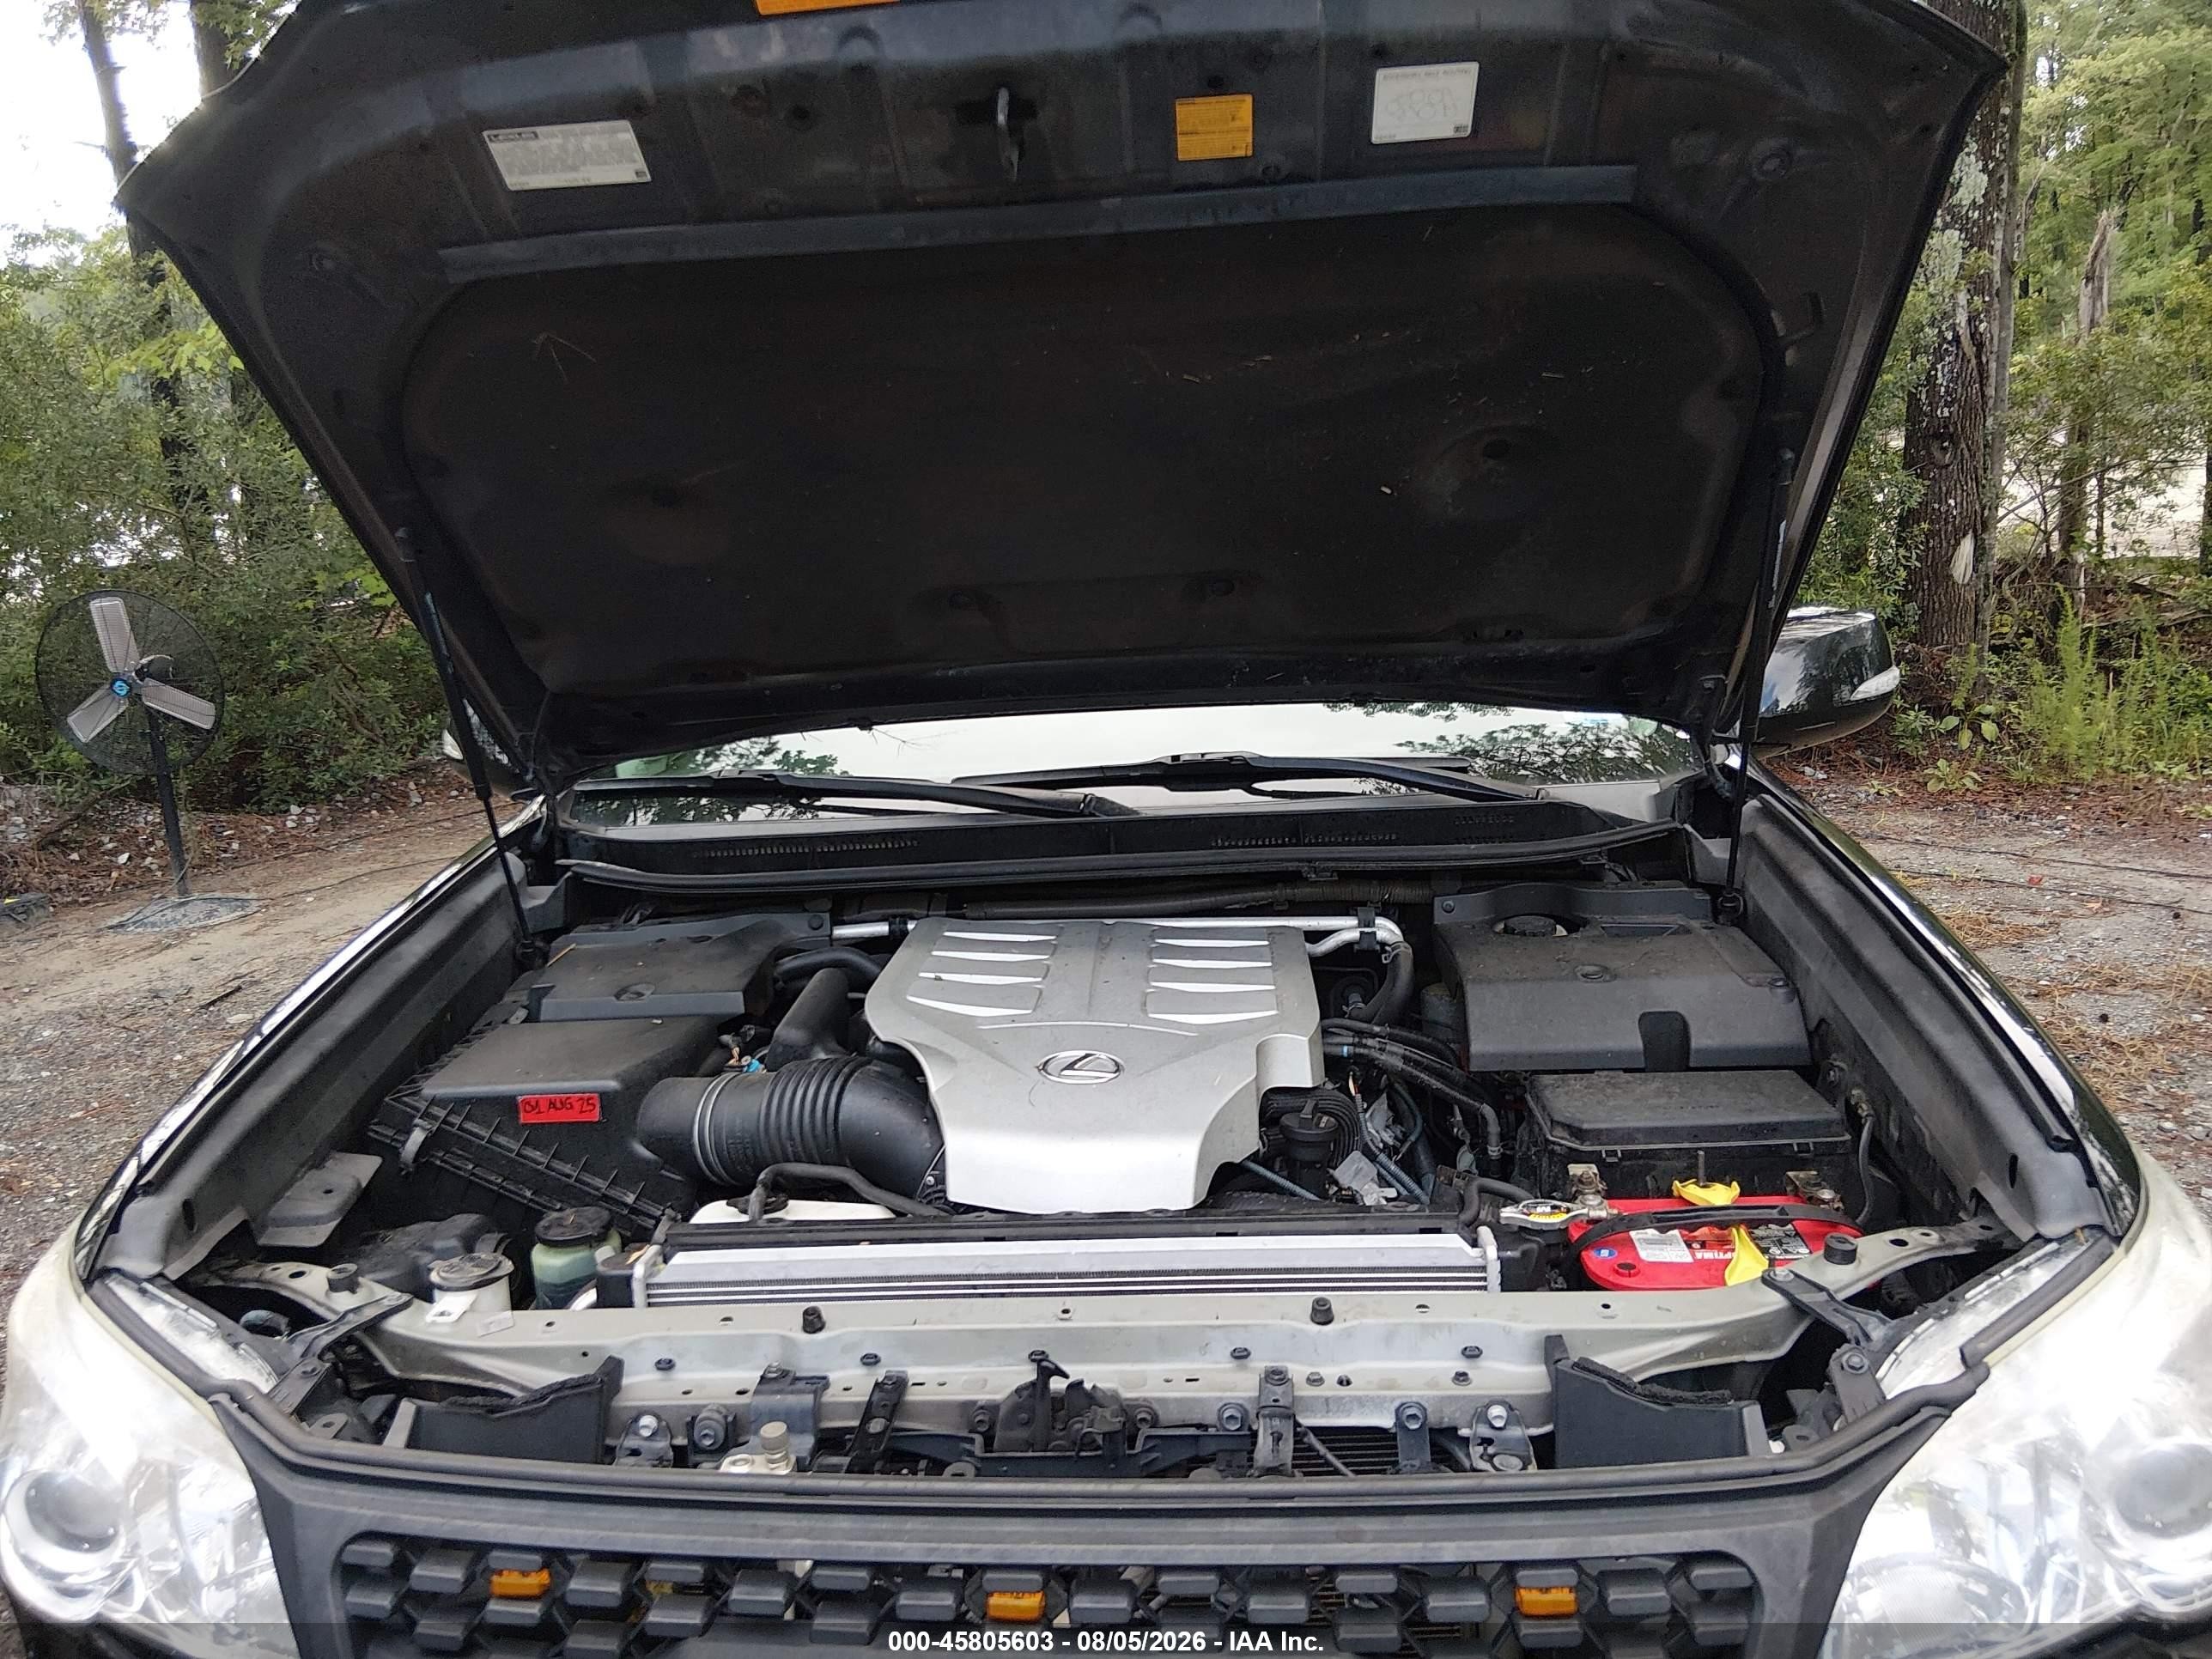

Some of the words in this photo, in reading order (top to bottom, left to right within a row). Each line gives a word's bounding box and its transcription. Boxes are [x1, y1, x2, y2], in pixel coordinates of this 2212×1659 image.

[547, 1097, 574, 1113] AUG
[576, 1097, 596, 1114] 25
[1694, 1249, 1735, 1260] PTIMA
